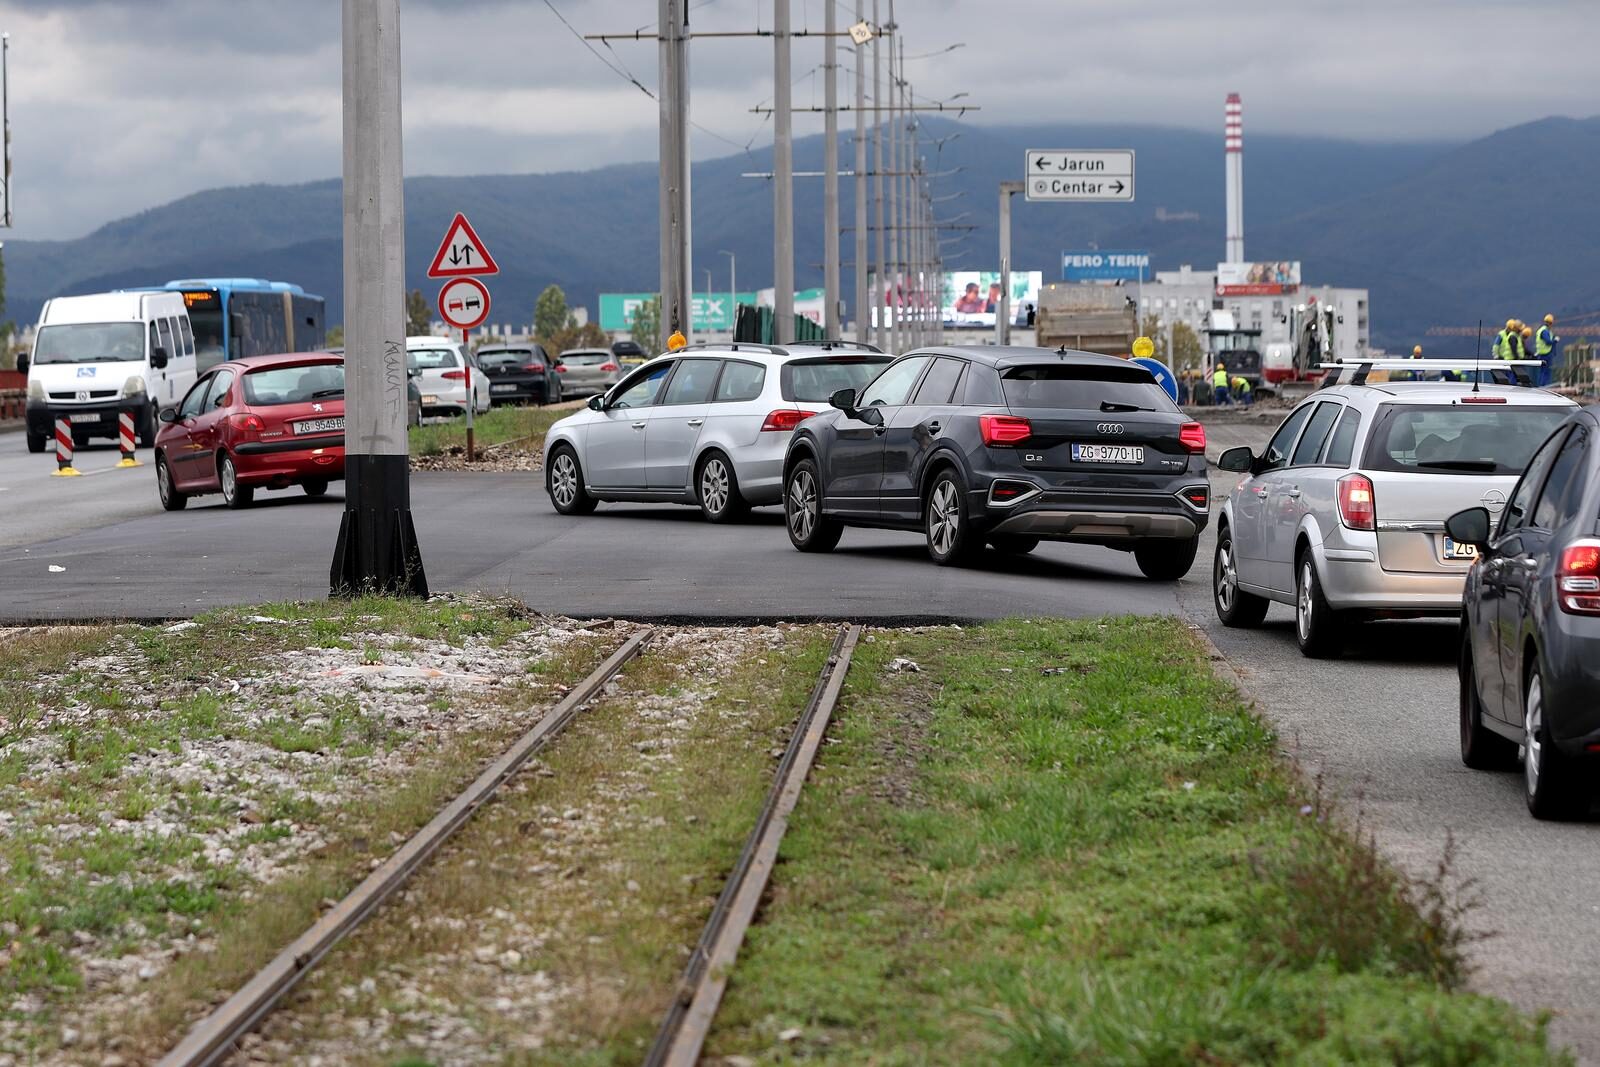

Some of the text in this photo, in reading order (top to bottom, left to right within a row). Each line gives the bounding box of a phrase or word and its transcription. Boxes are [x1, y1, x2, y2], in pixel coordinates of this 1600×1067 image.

[1058, 157, 1104, 171] Jarun
[1051, 179, 1104, 193] Centar
[299, 422, 311, 432] ZG
[1080, 446, 1094, 458] ZG
[1456, 543, 1474, 555] ZG
